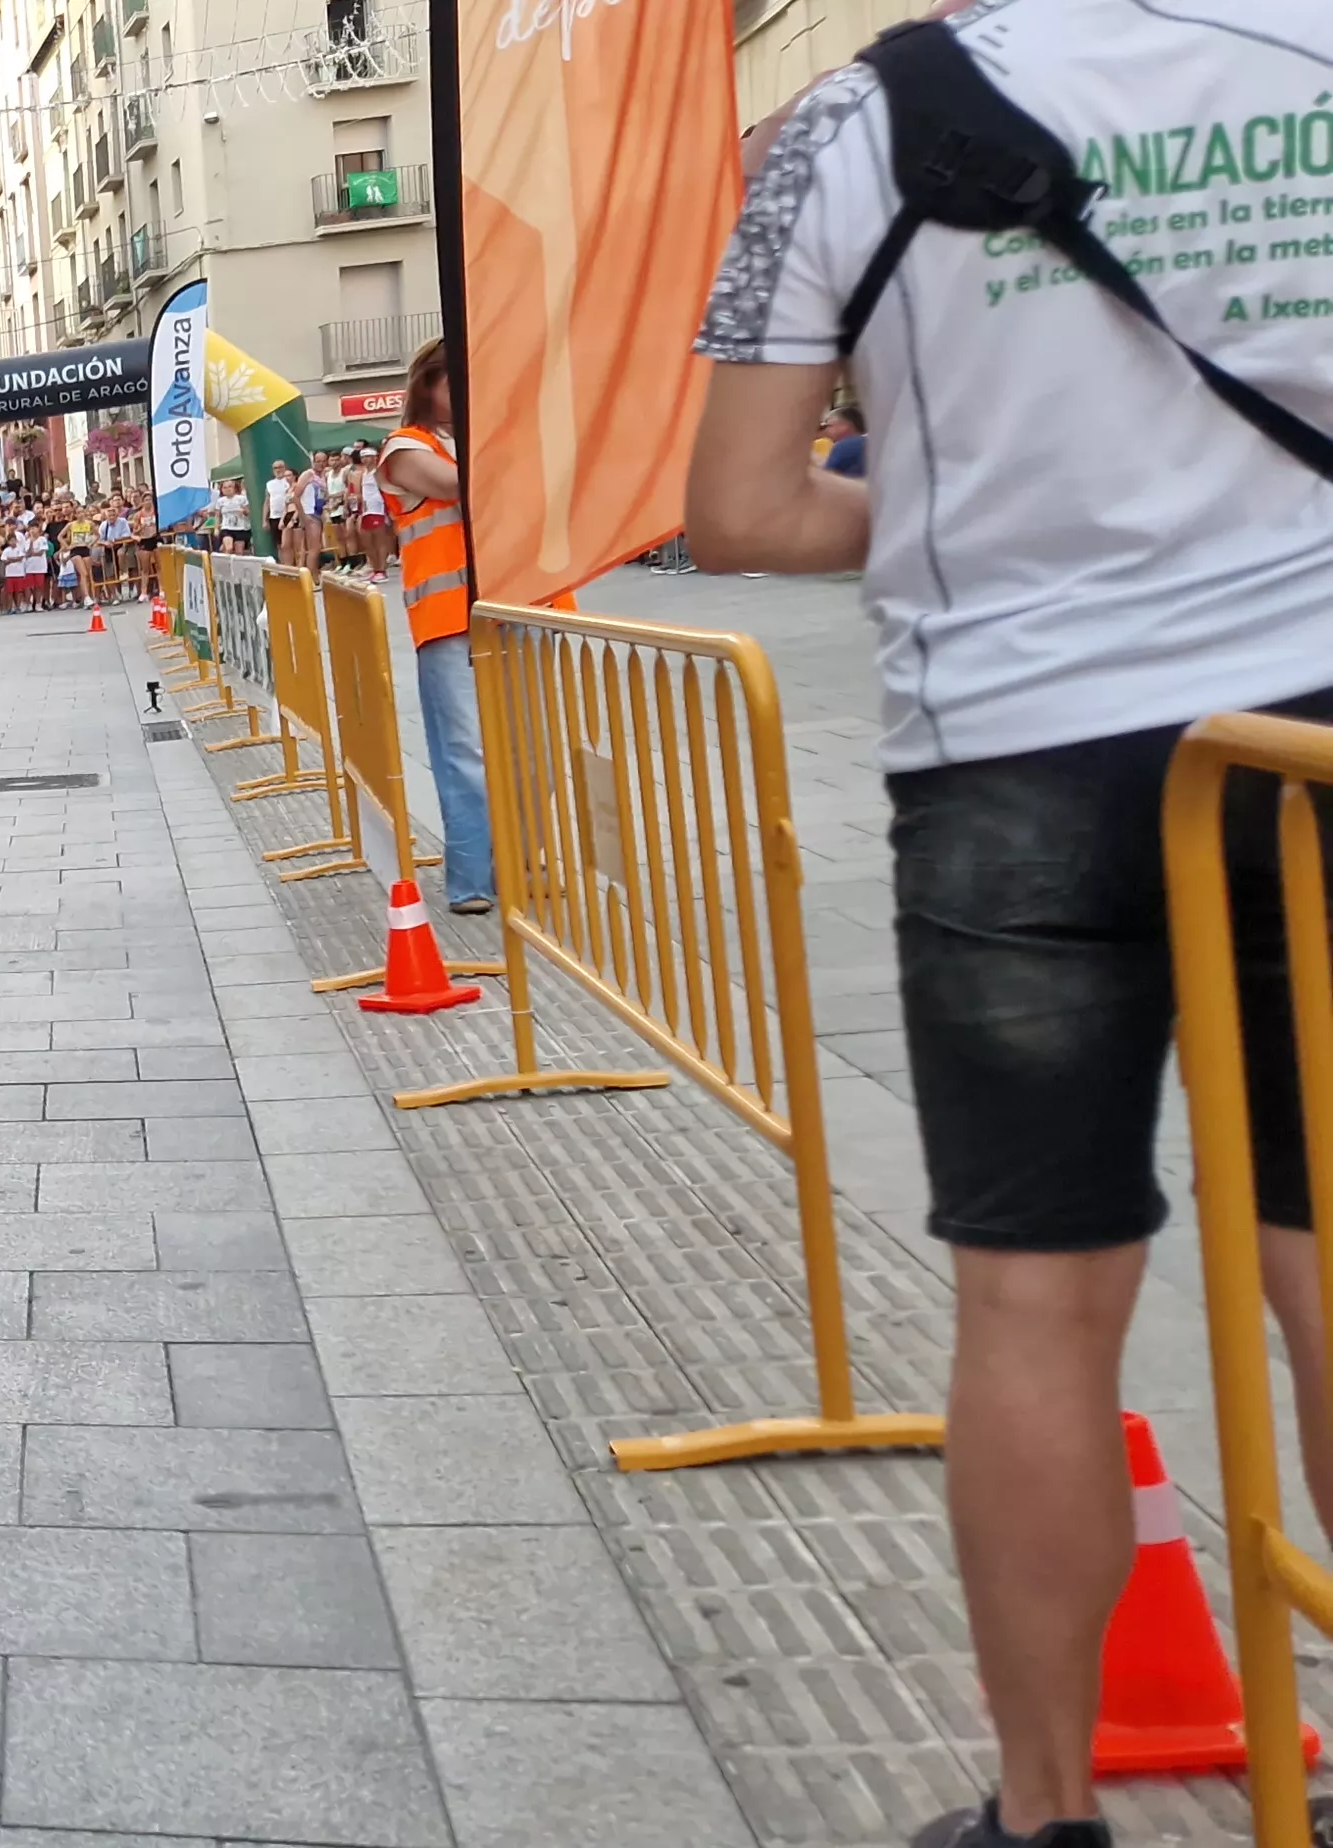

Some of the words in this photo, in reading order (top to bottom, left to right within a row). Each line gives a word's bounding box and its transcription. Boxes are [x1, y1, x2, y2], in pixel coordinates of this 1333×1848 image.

[1080, 90, 1333, 199] ANIZACIÓ
[1105, 211, 1158, 240] pies
[1167, 210, 1208, 231] en
[1219, 199, 1251, 224] la
[986, 279, 1005, 307] y
[1016, 264, 1040, 293] el
[1173, 245, 1213, 271] en
[1227, 240, 1257, 265] la
[1223, 296, 1248, 322] A
[1262, 293, 1333, 320] Ixen
[59, 390, 82, 404] DE
[87, 377, 148, 399] ARAGÓ
[168, 317, 193, 478] OrtoAvanza
[363, 395, 403, 411] GAES
